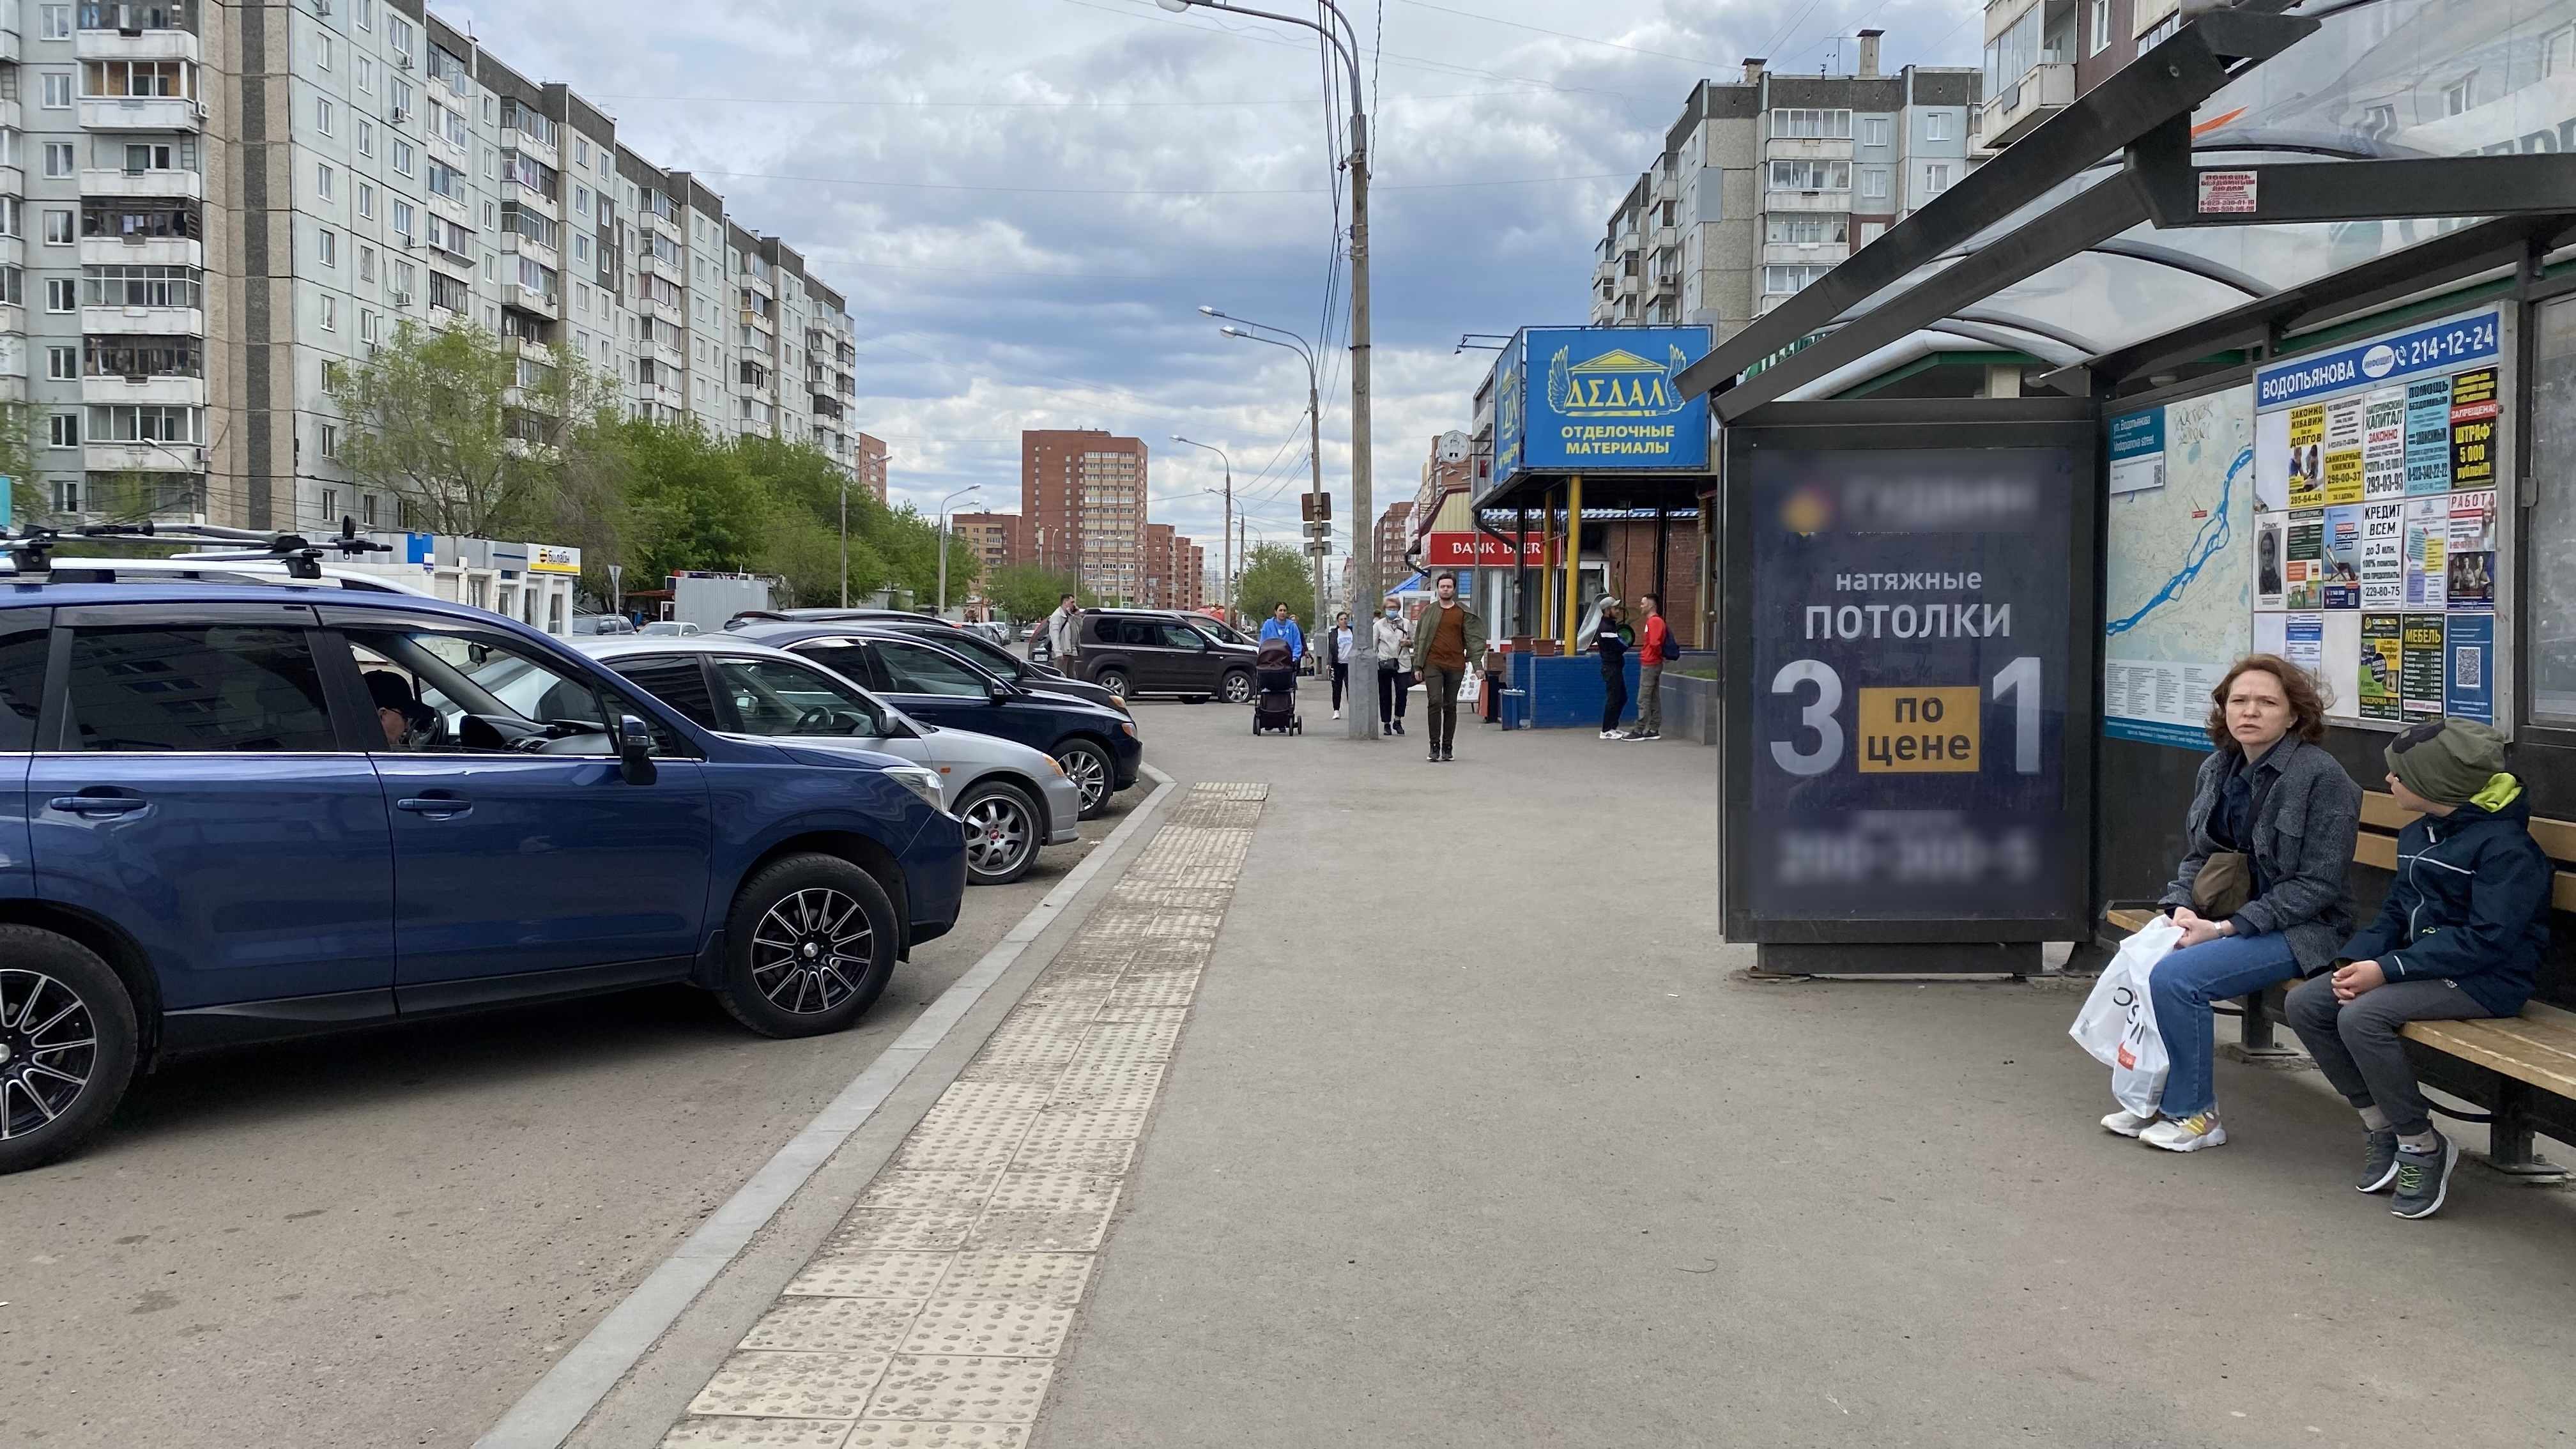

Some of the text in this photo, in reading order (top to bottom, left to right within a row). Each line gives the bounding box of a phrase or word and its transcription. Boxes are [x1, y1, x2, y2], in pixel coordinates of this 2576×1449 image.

[2262, 360, 2356, 400] ВОДОПЬЯНОВА
[2411, 323, 2494, 365] 214-12-24
[2291, 406, 2323, 419] ЗАКОННО
[2365, 410, 2403, 430] КАПИТАЛ
[2291, 417, 2323, 429] ИЗБАВИМ
[1561, 425, 1675, 441] ОТДЕЛОЧНЫЕ
[2290, 433, 2322, 448] ДОЛГОВ
[2368, 429, 2398, 443] ЗАКОННО
[1566, 442, 1669, 454] МАТЕРИАЛЫ
[2460, 447, 2466, 463] 5
[2467, 444, 2485, 462] 000
[2325, 452, 2361, 463] САНИТАРНЫЕ
[2366, 472, 2404, 494] 293-03-93
[2451, 493, 2495, 509] РАБОТА
[2365, 503, 2401, 521] КРЕДИТ
[2369, 522, 2396, 535] ВСЕМ
[1503, 542, 1541, 554] BER
[2375, 543, 2380, 555] 3
[1836, 571, 1982, 592] натяжные
[2365, 586, 2401, 596] 229-80-75
[1805, 603, 2011, 640] ПОТОЛКИ
[2405, 629, 2441, 643] МЕБЕЛЬ
[1770, 658, 1844, 776] 3
[1895, 696, 1944, 723] по
[1993, 657, 2041, 772] 1
[1867, 734, 1971, 767] цене
